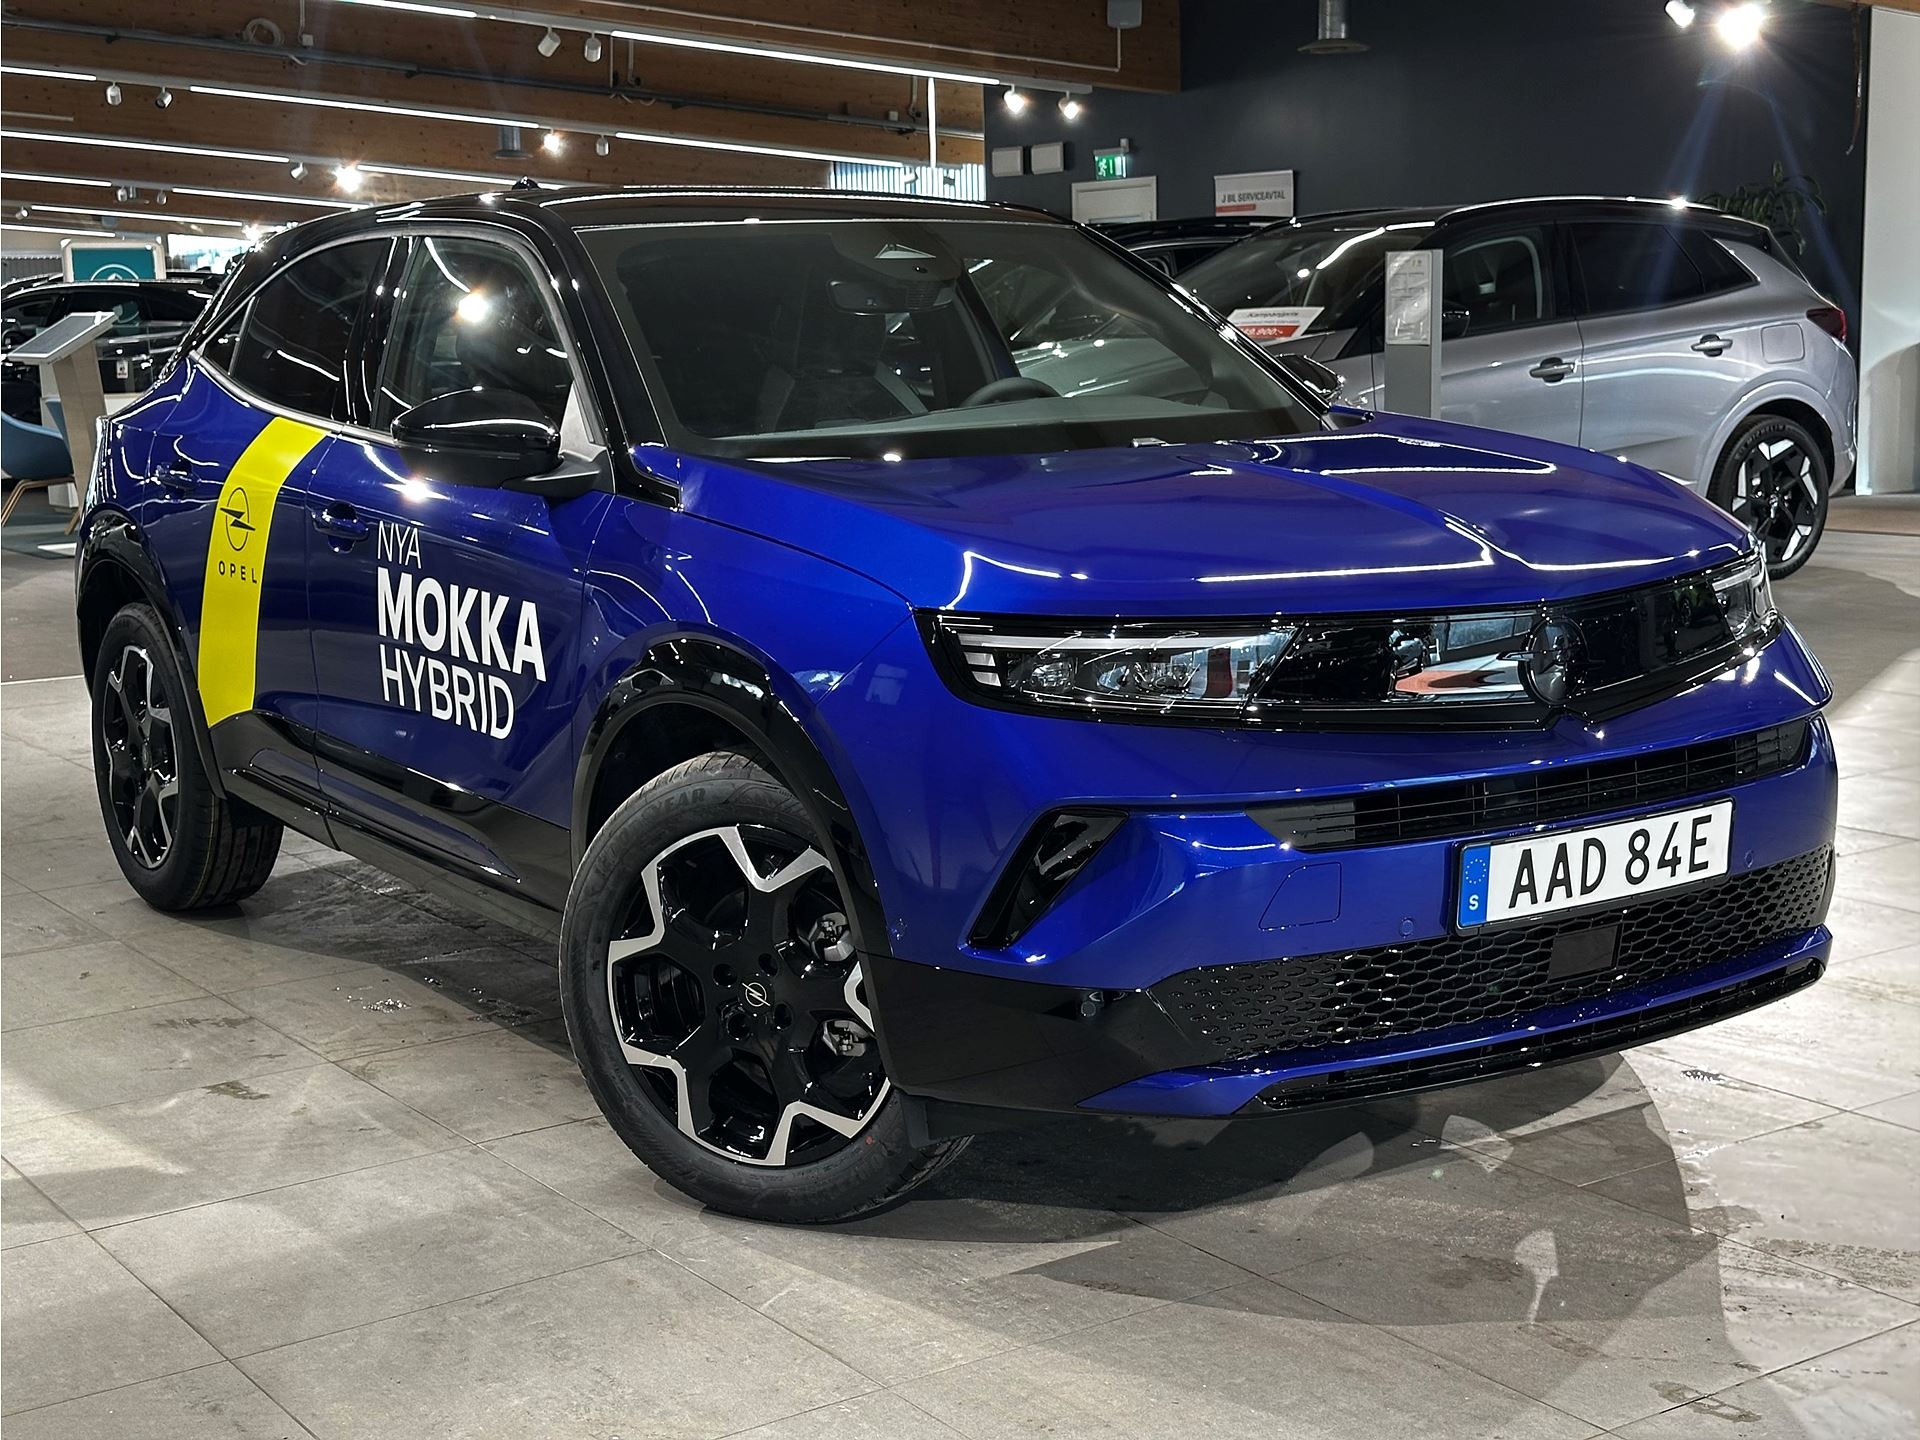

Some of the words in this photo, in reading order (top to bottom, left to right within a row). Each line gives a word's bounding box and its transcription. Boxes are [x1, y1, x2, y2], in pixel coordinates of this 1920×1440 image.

[218, 560, 257, 584] OPEL
[377, 520, 422, 569] NYA
[377, 566, 547, 682] MOKKA
[379, 643, 515, 740] HYBRID
[1508, 837, 1607, 909] AAD
[1625, 814, 1712, 886] 84E
[1468, 894, 1480, 911] S
